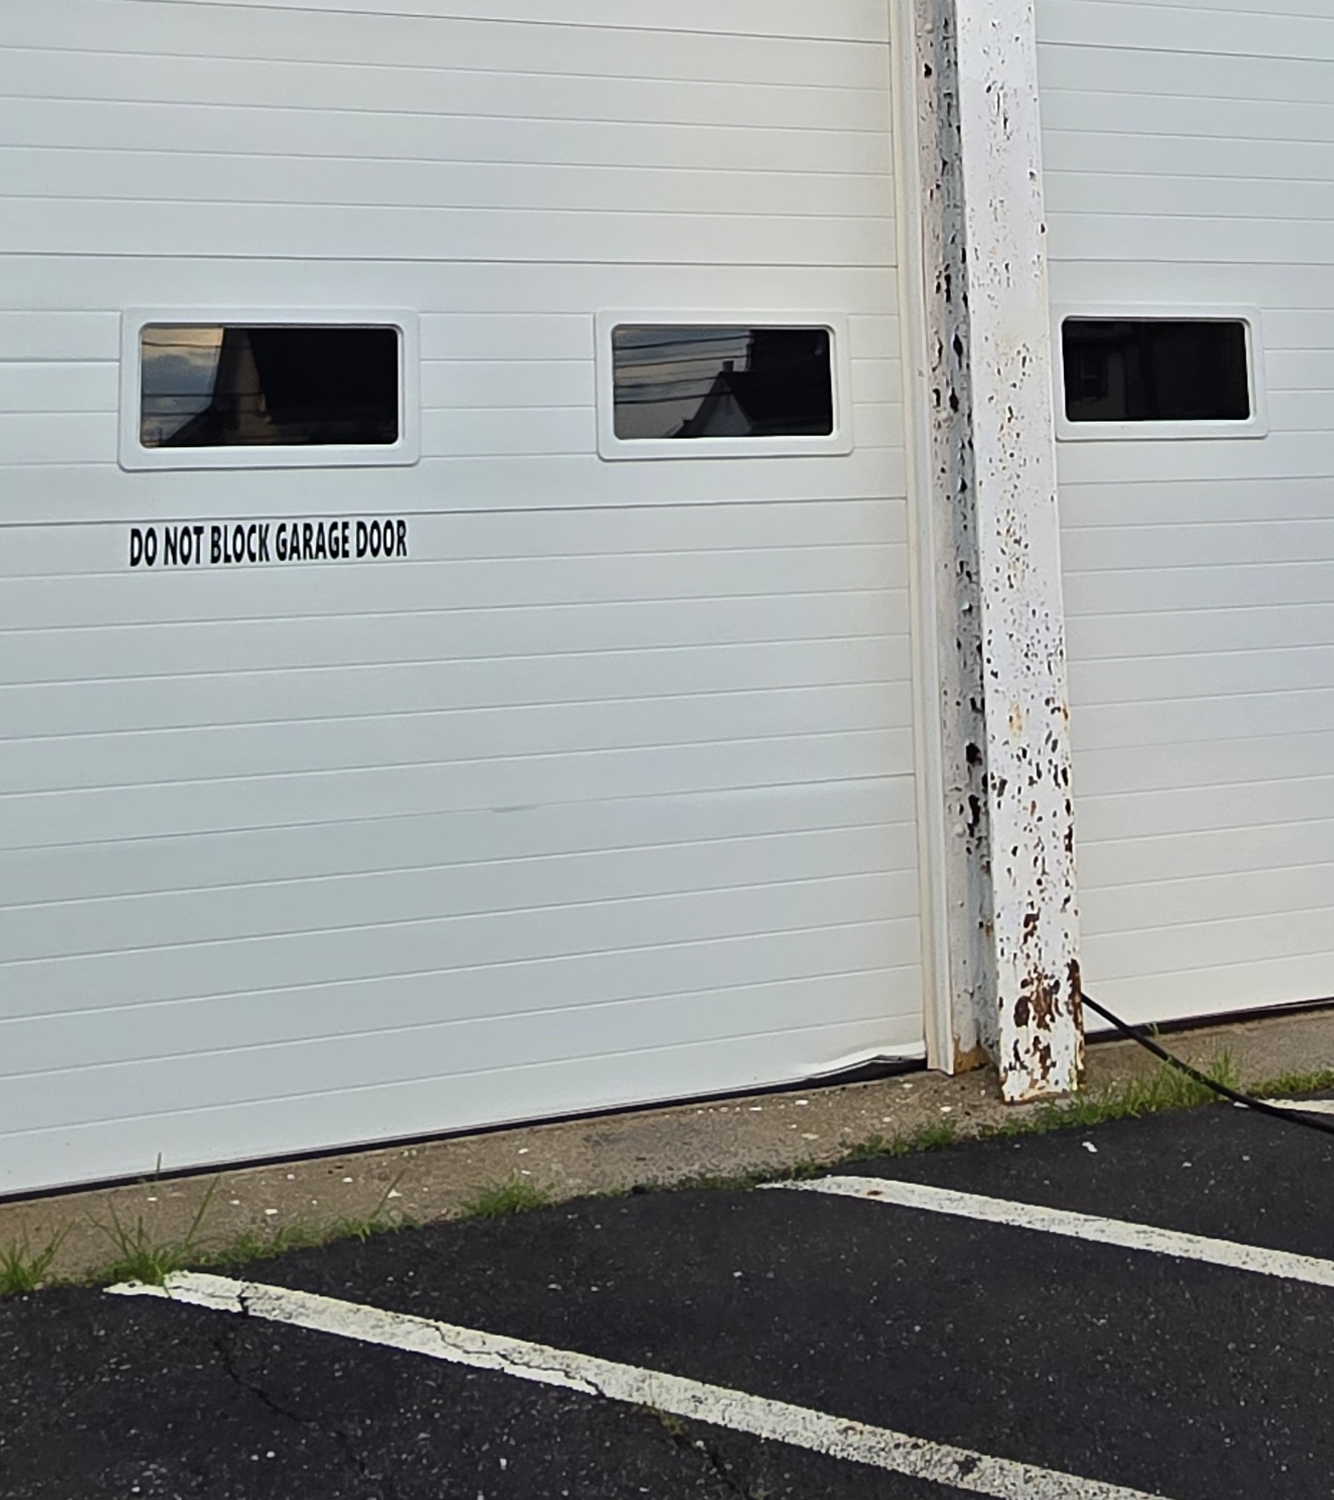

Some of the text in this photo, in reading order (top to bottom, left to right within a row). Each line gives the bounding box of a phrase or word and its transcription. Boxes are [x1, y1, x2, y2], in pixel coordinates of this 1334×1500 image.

[130, 519, 408, 567] DO NOT BLOCK GARAGE DOOR
